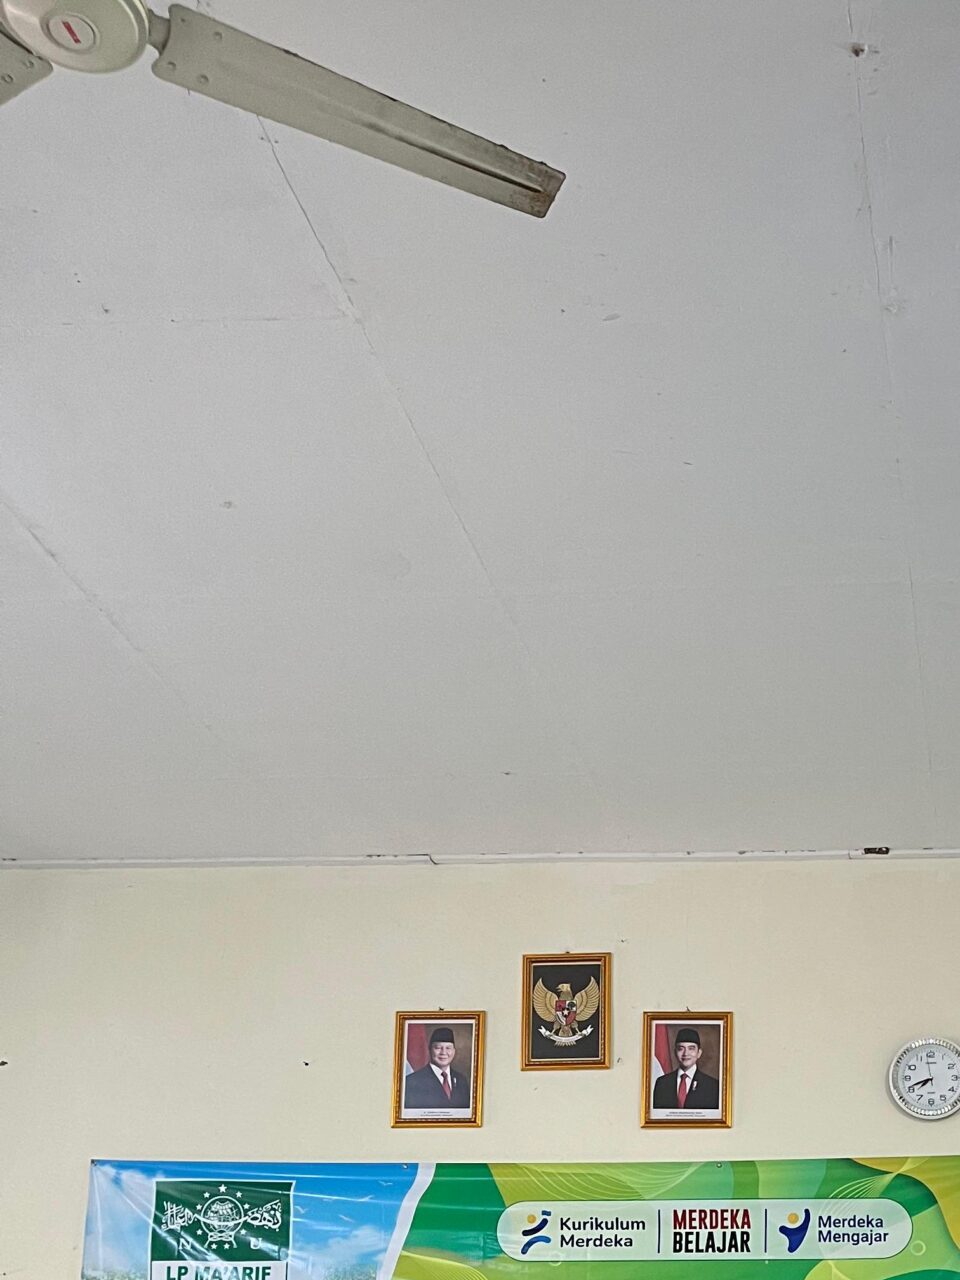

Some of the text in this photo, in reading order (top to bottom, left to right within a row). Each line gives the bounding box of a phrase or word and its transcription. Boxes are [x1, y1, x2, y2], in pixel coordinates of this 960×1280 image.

[916, 1094, 923, 1102] 7
[559, 1216, 646, 1231] Kurikulum
[671, 1208, 752, 1230] MERDEKA
[817, 1215, 884, 1229] Merdeka
[178, 1238, 262, 1250] N U
[559, 1233, 634, 1249] Merdeka
[671, 1231, 752, 1254] BELAJAR
[817, 1229, 889, 1246] Mengajar
